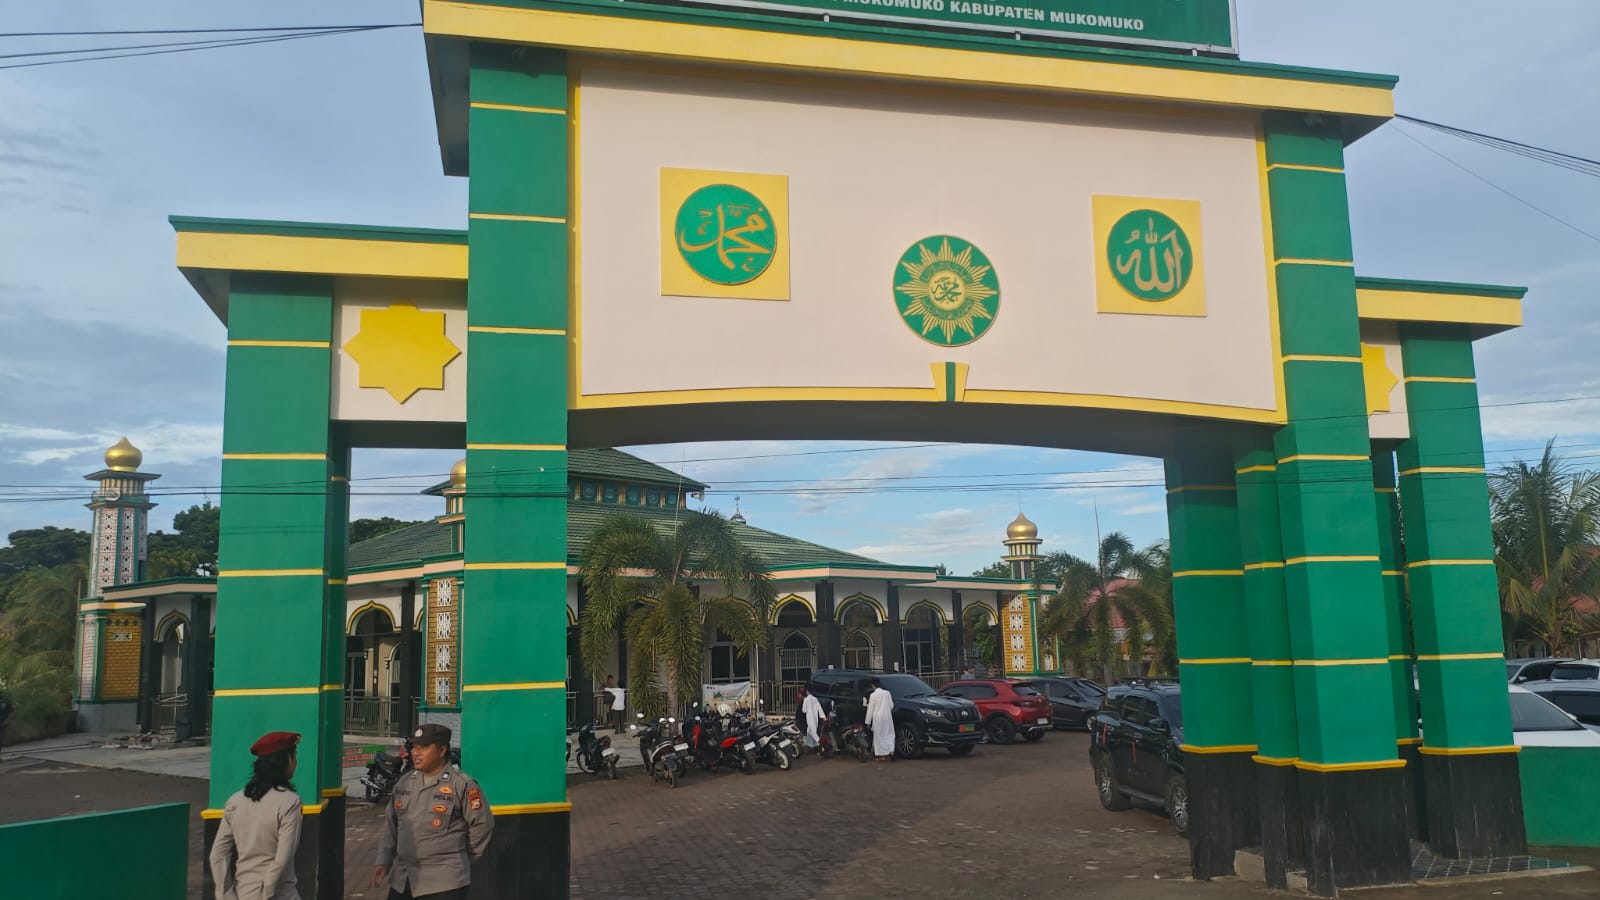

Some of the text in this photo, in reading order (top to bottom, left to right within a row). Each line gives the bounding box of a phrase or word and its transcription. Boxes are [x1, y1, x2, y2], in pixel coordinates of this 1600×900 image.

[843, 0, 1144, 31] OMUKO KABUPATEN MUKOMUKO
